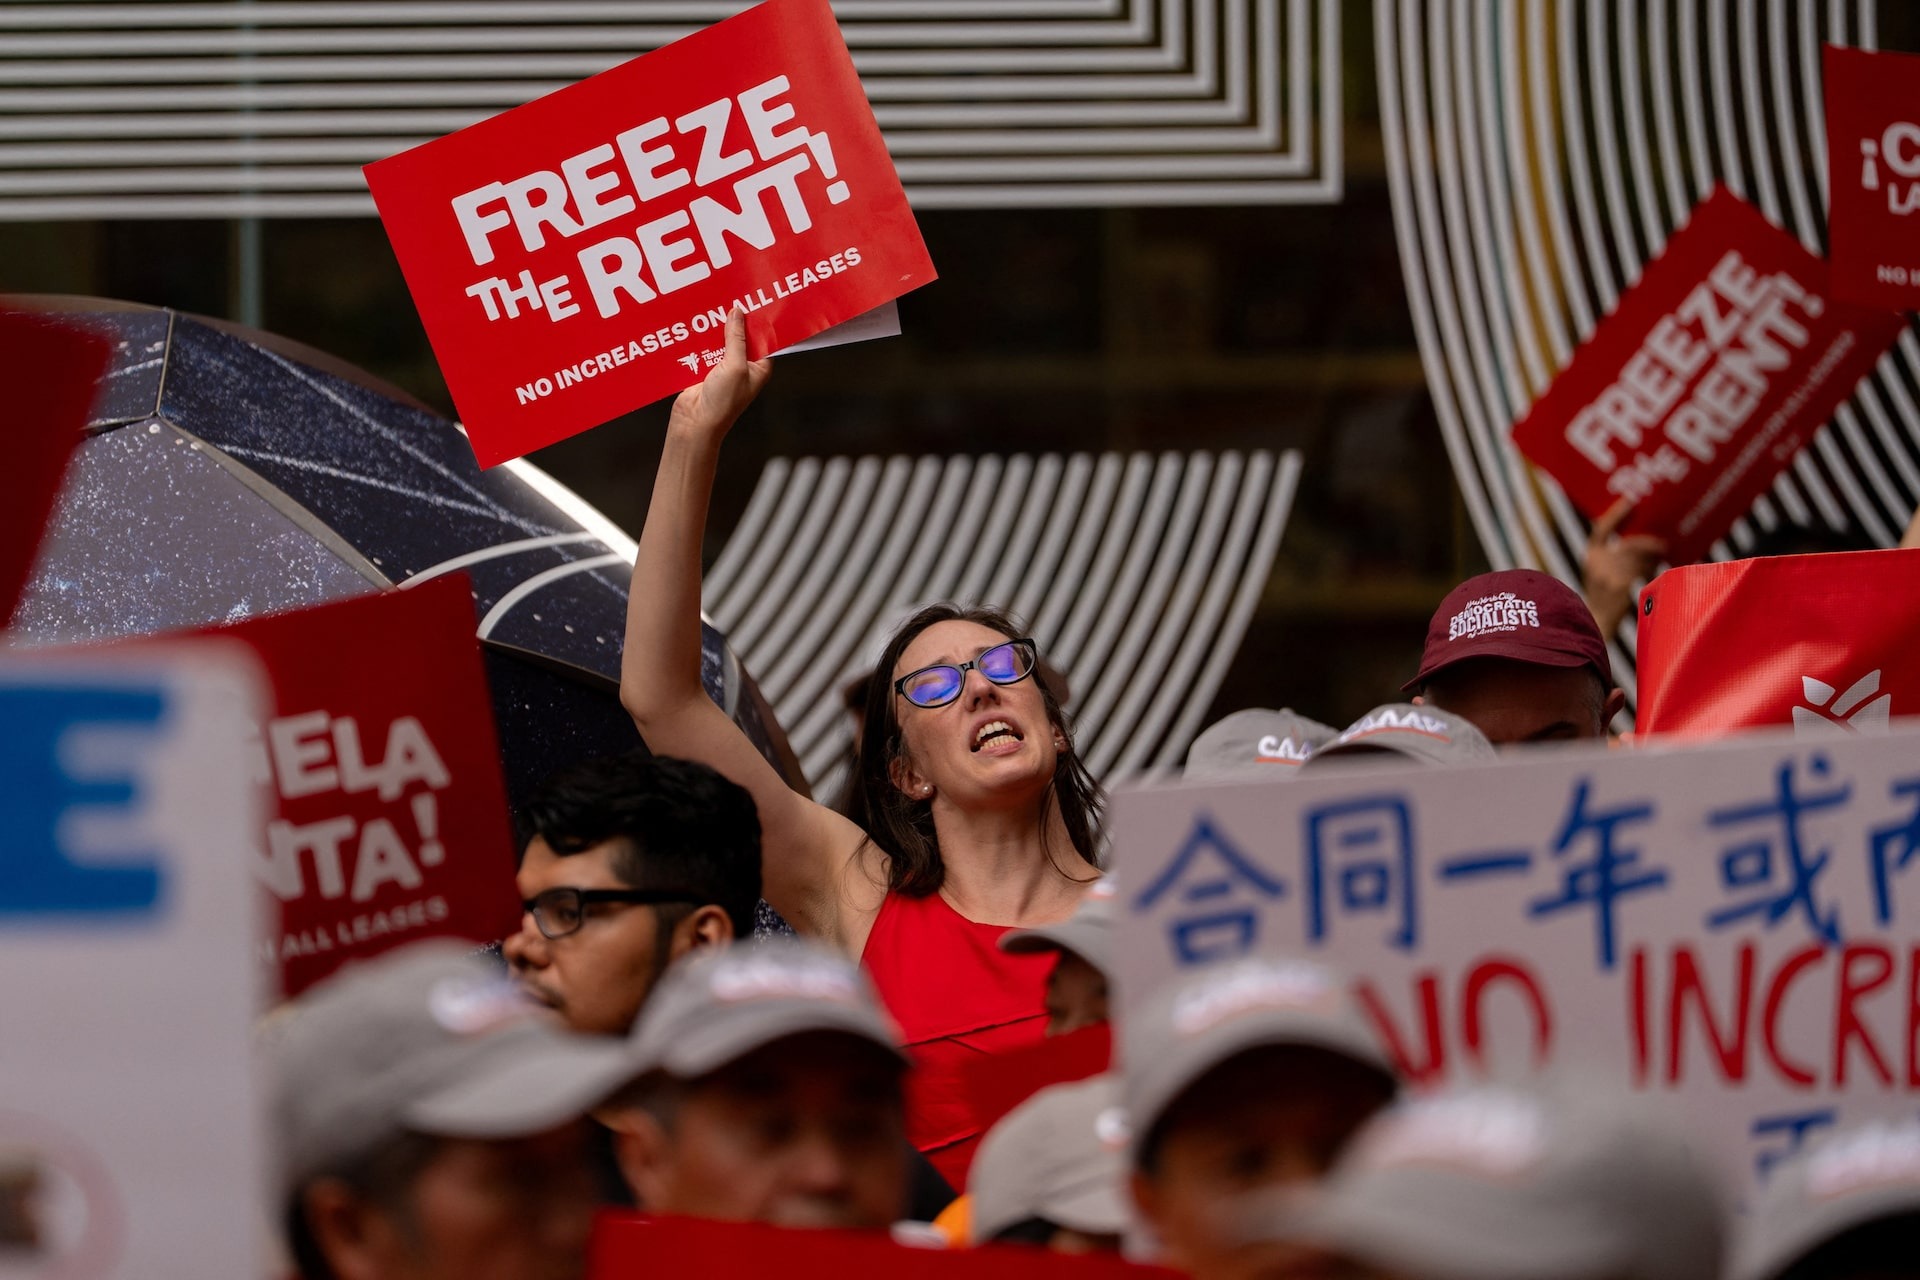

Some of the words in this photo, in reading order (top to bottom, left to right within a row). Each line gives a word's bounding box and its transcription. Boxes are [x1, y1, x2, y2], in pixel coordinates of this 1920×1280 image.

[451, 75, 811, 266] FREEZE
[465, 269, 580, 323] THE
[577, 131, 851, 319] RENT!
[1876, 264, 1908, 287] NO
[515, 378, 553, 405] NO
[554, 322, 690, 390] INCREASES
[691, 306, 728, 333] ON
[732, 288, 773, 315] ALL
[773, 247, 862, 300] LEASES
[1564, 249, 1775, 473] FREEZE
[1663, 271, 1824, 465] RENT!
[1448, 609, 1540, 642] SOCIALISTS
[1450, 599, 1537, 626] DEMOCRATIC
[1477, 624, 1517, 636] America
[282, 925, 334, 962] ALL
[336, 895, 449, 946] LEASES
